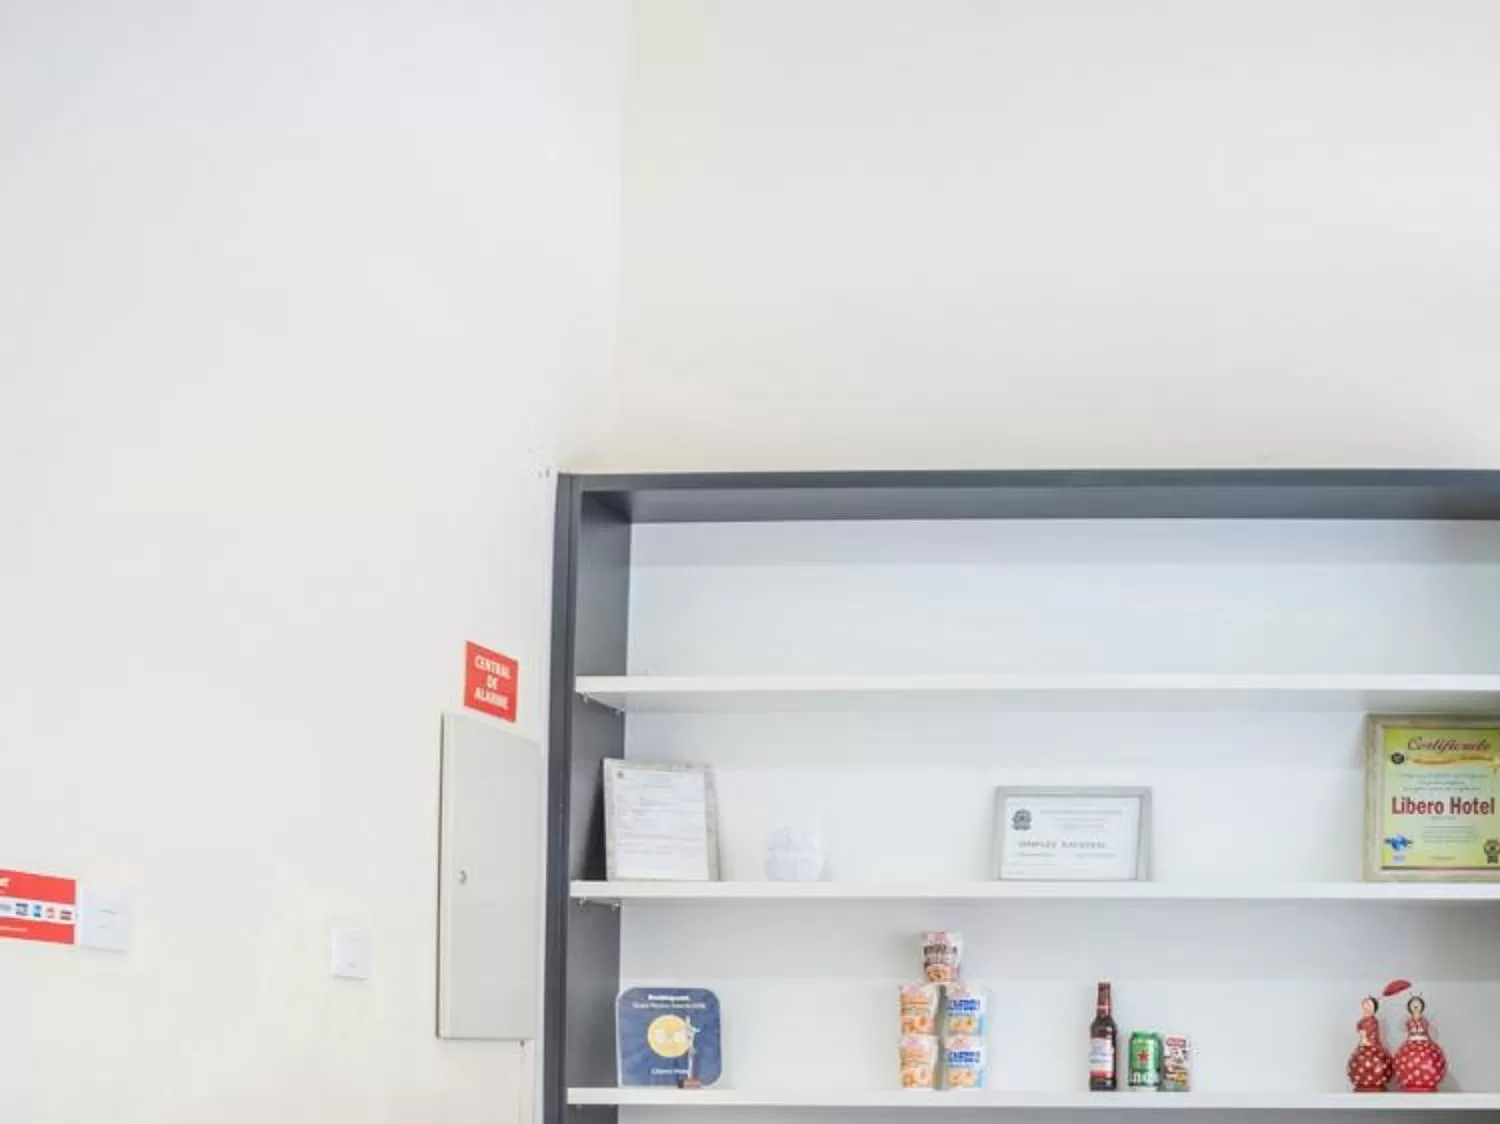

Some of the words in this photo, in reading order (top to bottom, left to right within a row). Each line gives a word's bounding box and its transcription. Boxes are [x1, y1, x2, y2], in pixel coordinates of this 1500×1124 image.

[475, 654, 512, 680] CENTRAL
[486, 674, 498, 691] DE
[474, 687, 509, 711] ALARME
[1391, 796, 1444, 815] Libero
[1450, 796, 1495, 815] Hotel
